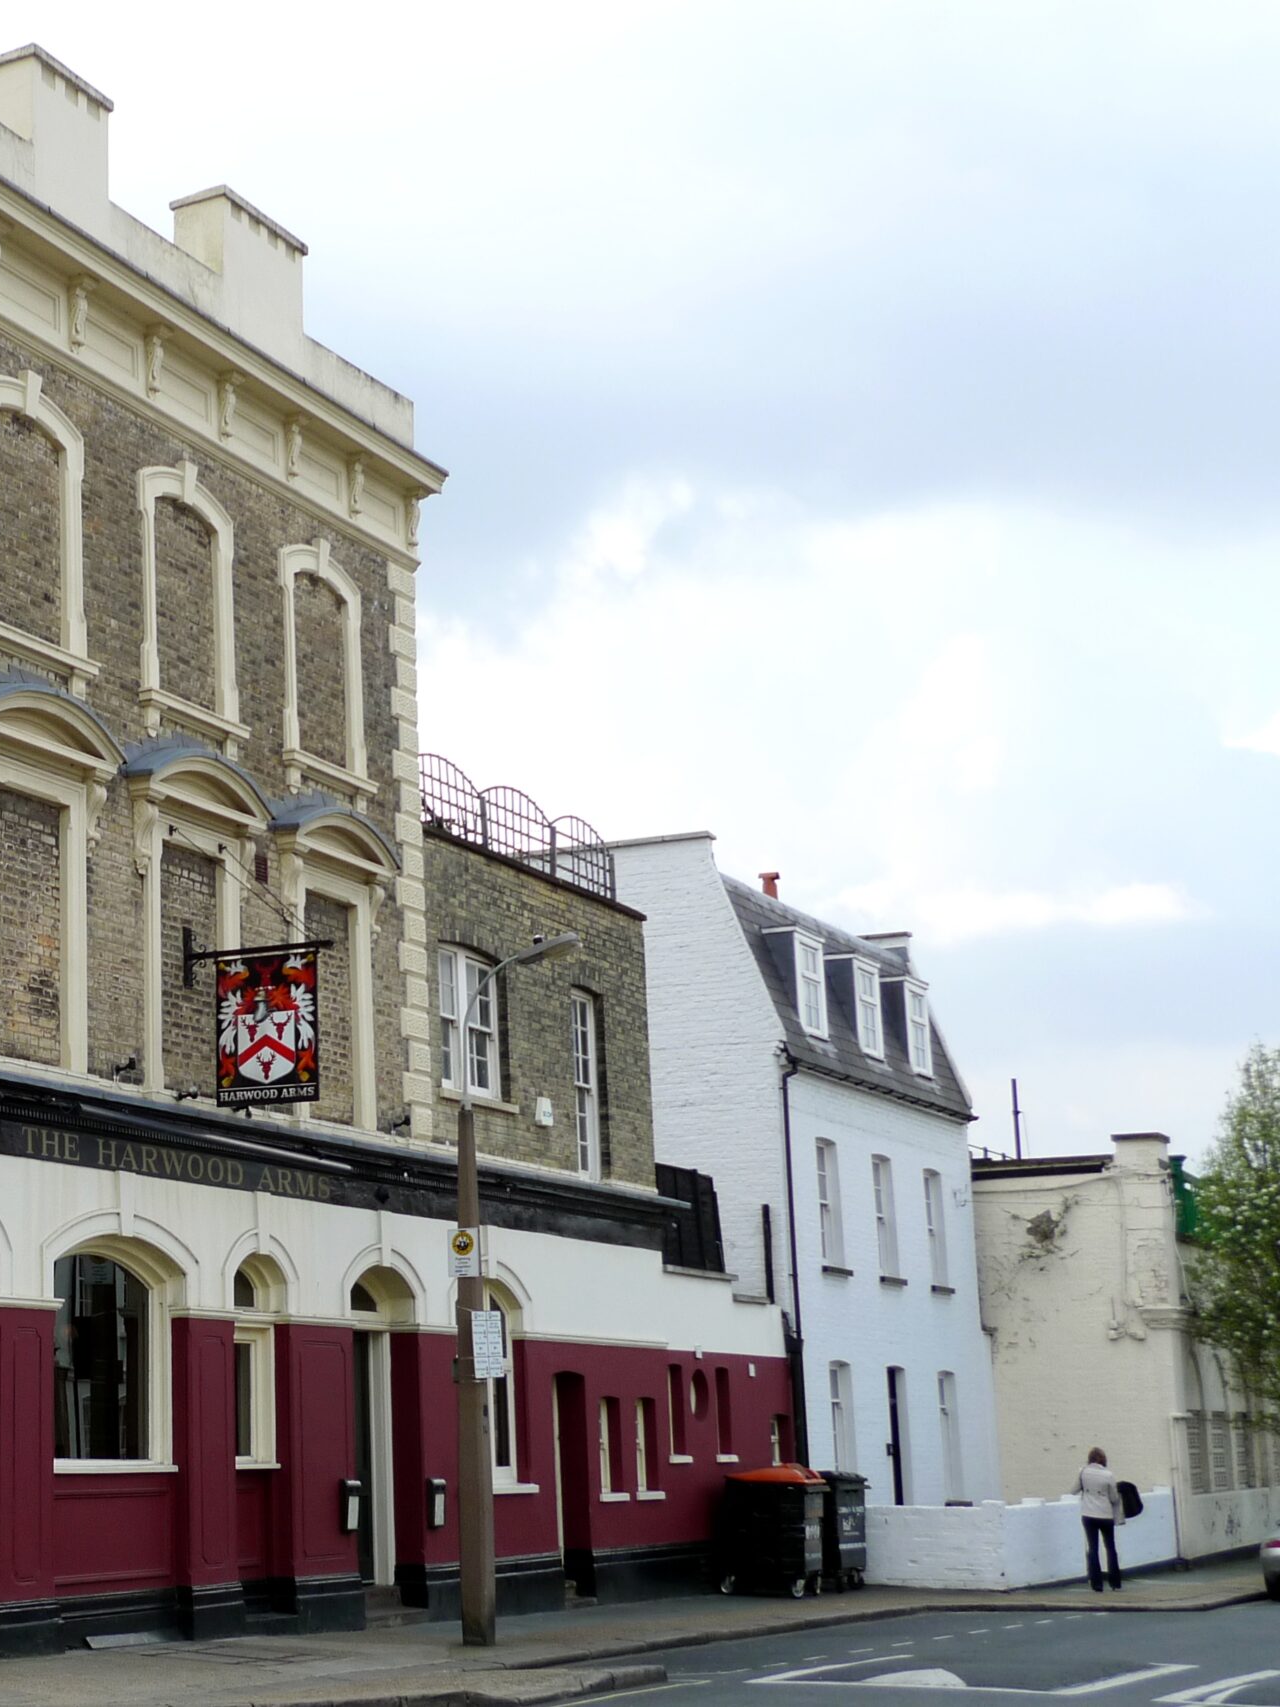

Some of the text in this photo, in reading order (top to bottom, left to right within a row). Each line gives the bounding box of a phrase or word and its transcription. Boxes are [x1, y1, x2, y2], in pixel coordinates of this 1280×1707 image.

[220, 1086, 315, 1102] HARWOOD ARMS
[22, 1126, 331, 1199] THE HARWOOD ARMS
